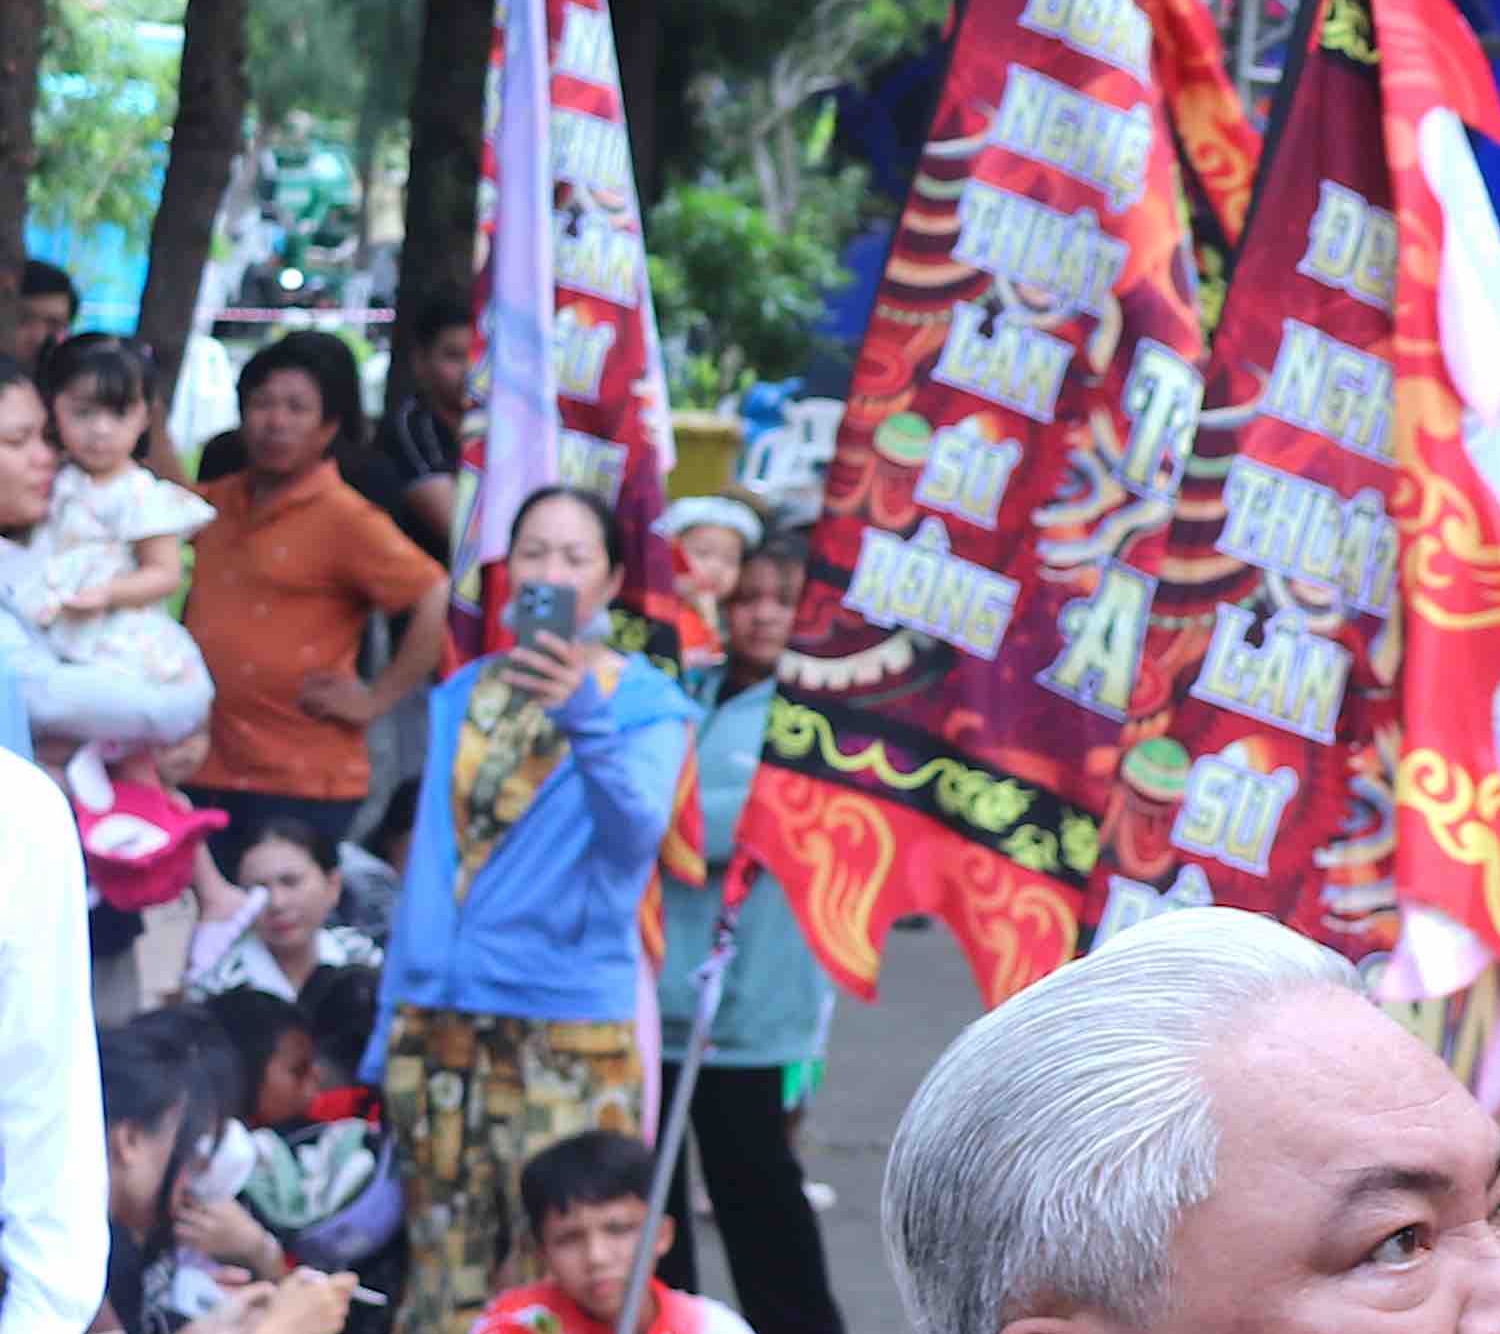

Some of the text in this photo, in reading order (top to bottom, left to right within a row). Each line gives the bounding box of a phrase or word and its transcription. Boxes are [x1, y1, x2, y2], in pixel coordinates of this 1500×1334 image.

[929, 300, 1077, 425] LÂN
[1255, 317, 1400, 467] NGH
[1189, 600, 1353, 747] LÂN
[1169, 753, 1299, 877] SƯ
